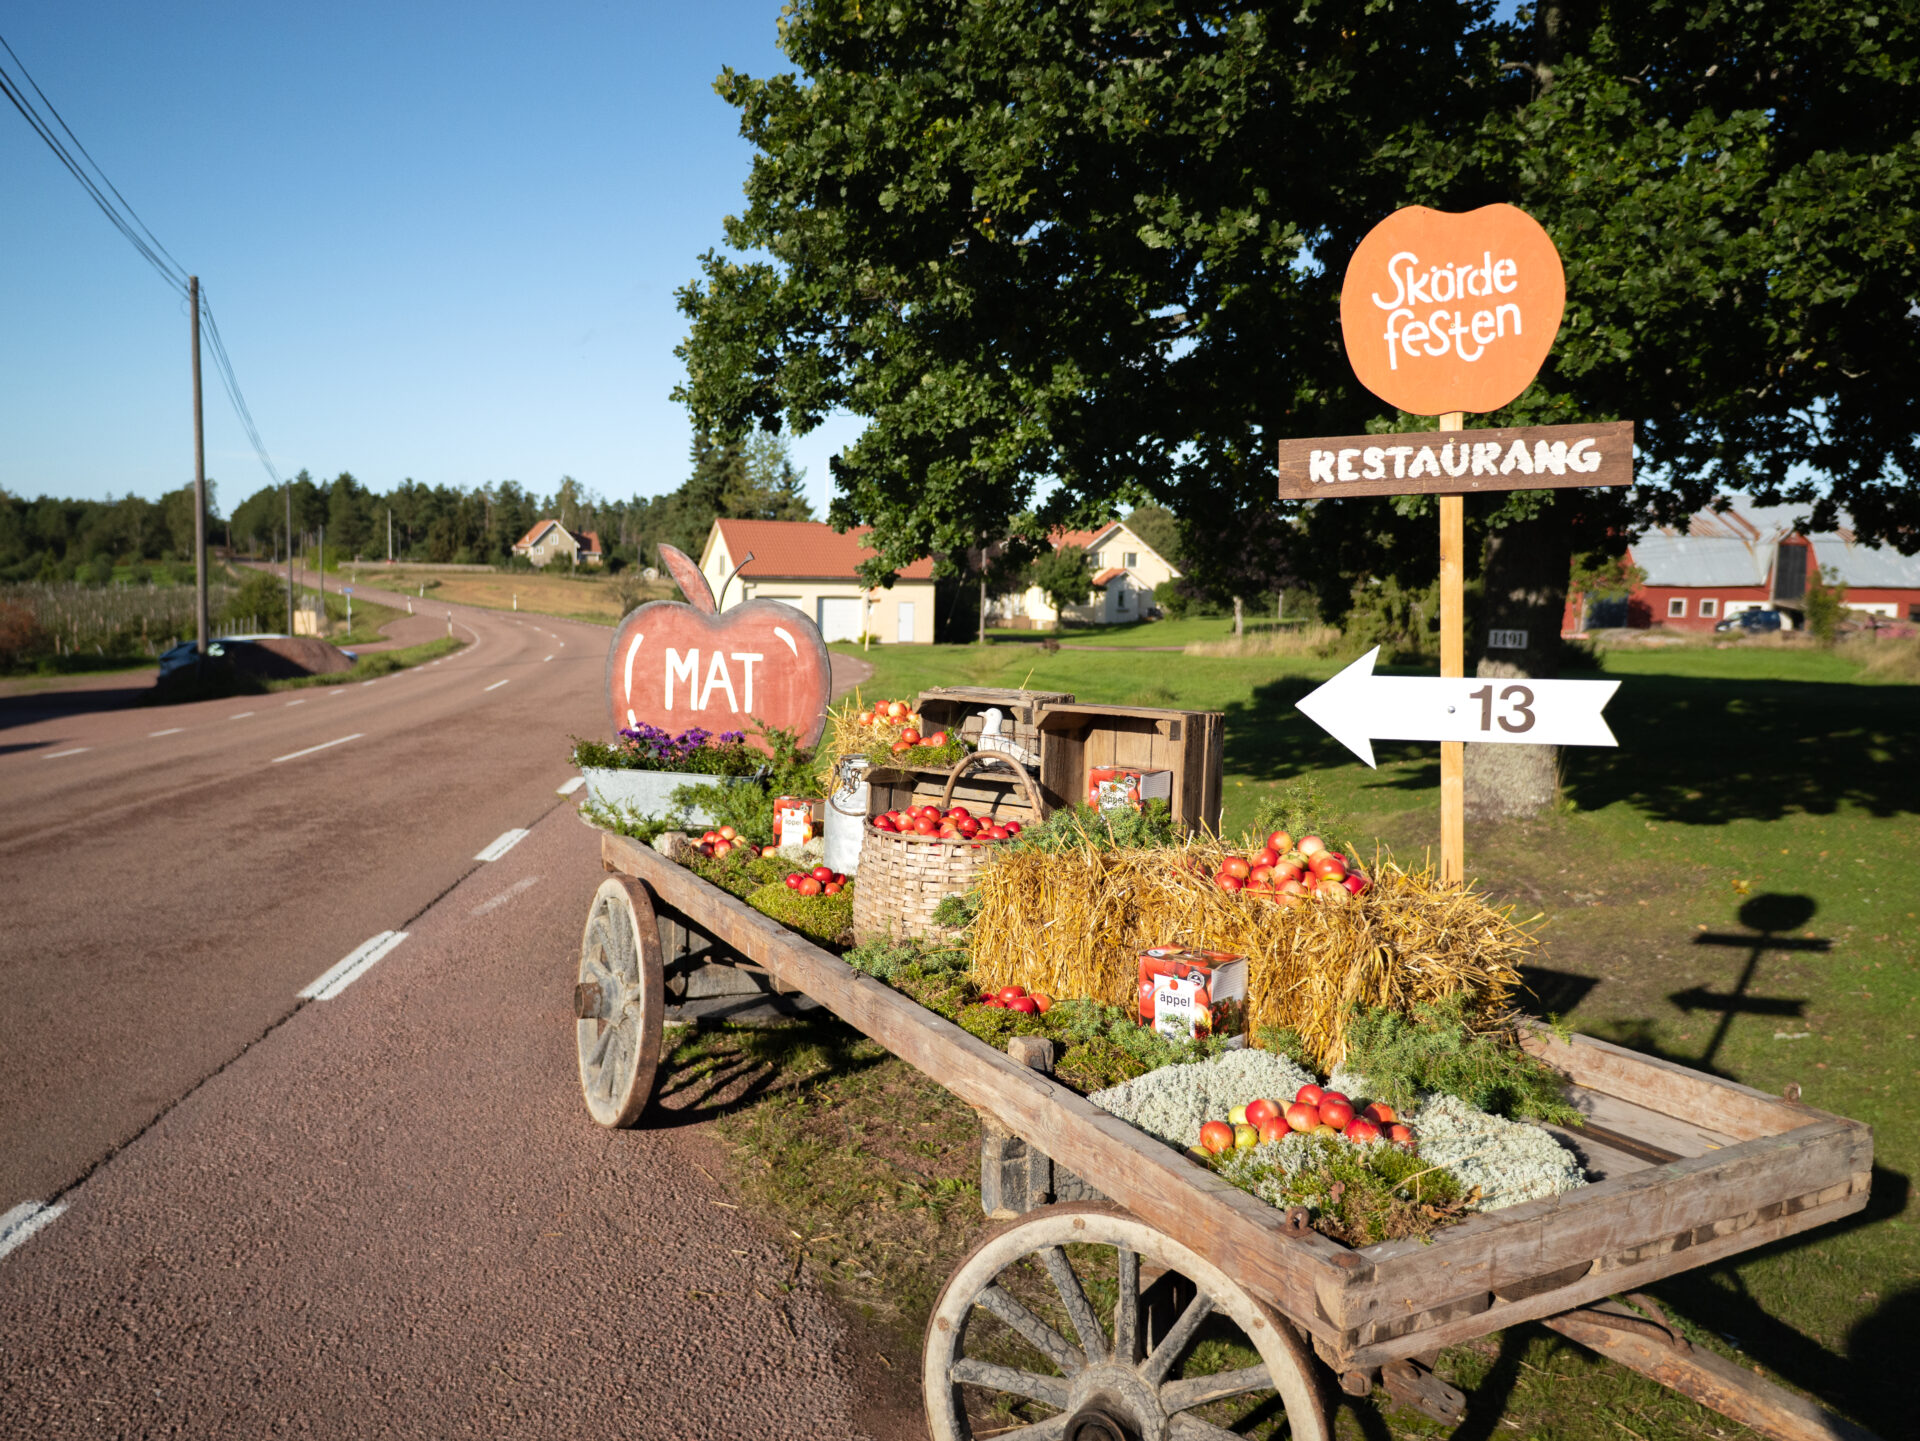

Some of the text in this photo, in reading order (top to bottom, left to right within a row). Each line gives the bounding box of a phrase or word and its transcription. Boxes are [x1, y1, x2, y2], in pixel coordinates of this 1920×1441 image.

[1372, 251, 1518, 310] Skörde
[1383, 302, 1522, 370] festen
[1309, 438, 1603, 483] RESTAURANG
[664, 647, 764, 714] MAT
[1469, 685, 1536, 733] 13
[1160, 991, 1191, 1008] äppel
